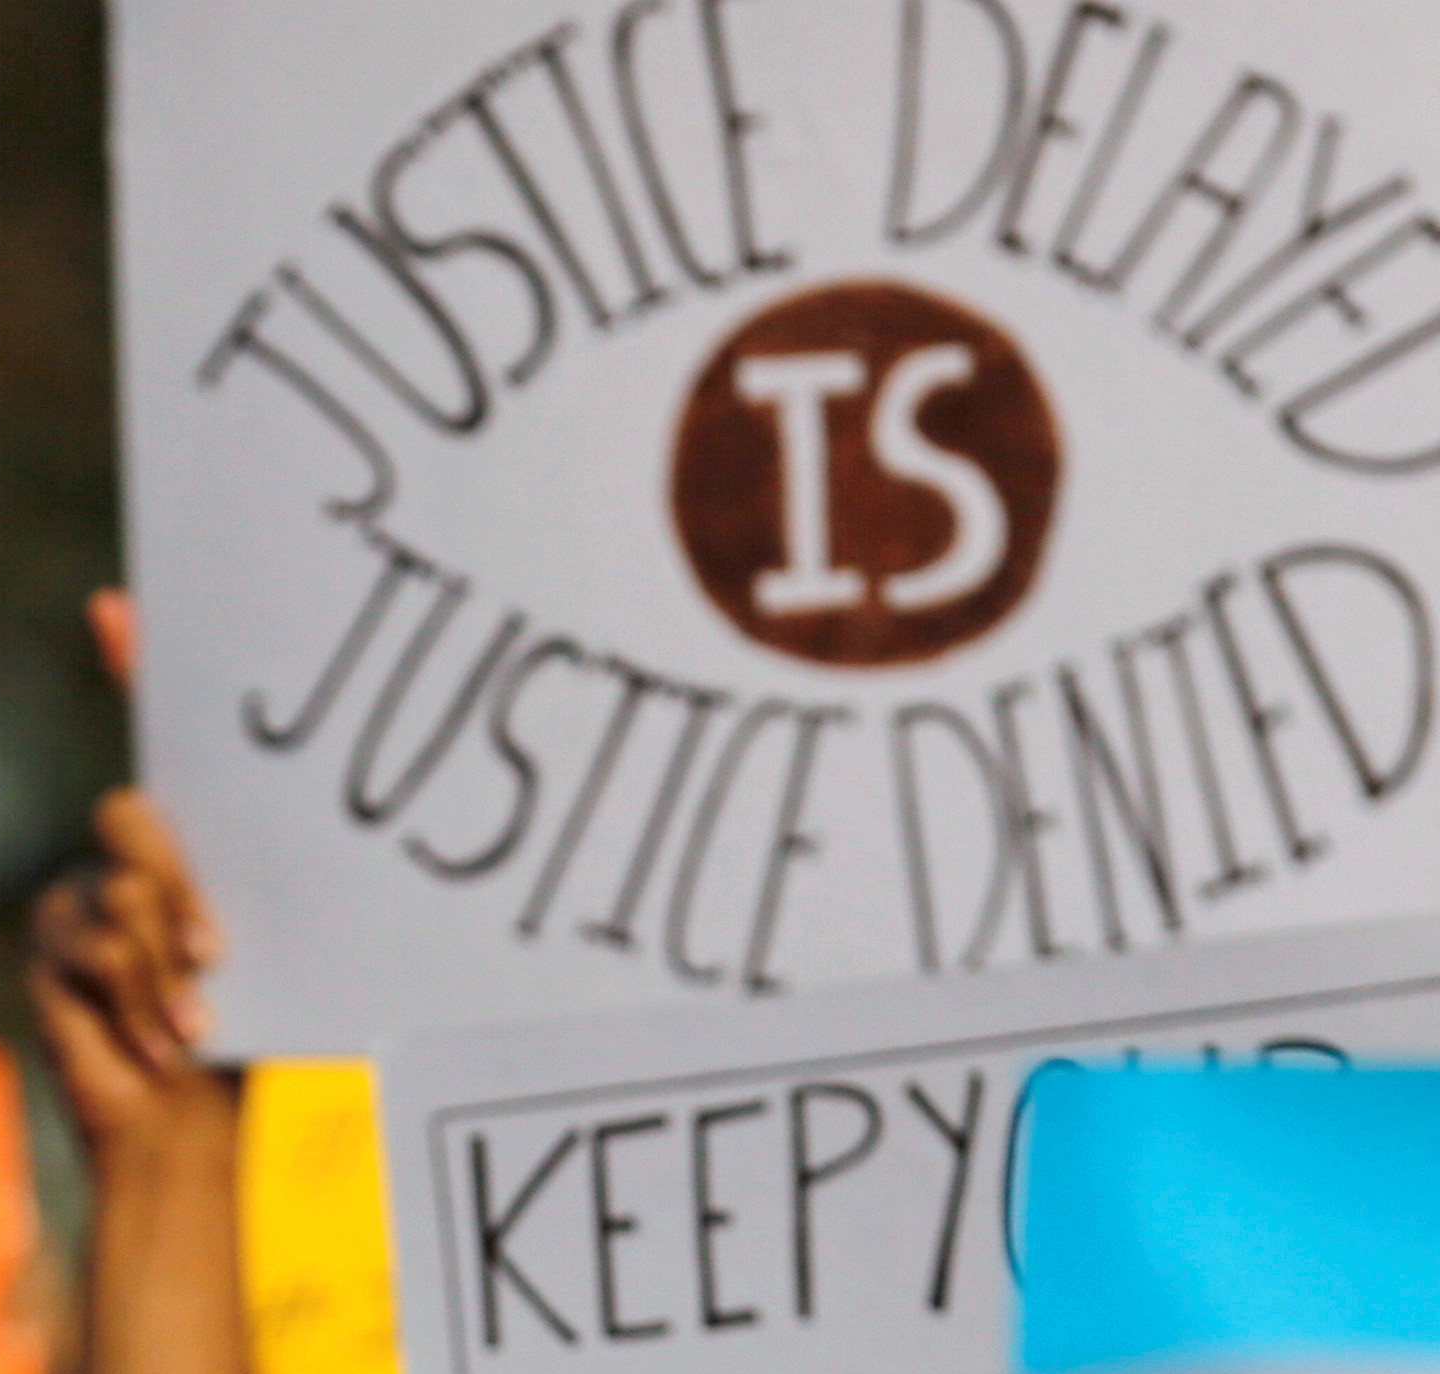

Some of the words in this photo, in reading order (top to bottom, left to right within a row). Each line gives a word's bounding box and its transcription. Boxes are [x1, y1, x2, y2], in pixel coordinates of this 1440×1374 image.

[195, 0, 796, 522] JUSTICE
[732, 342, 1010, 618] IS
[244, 512, 855, 994] JUSTICE
[890, 542, 1435, 976] DENIED
